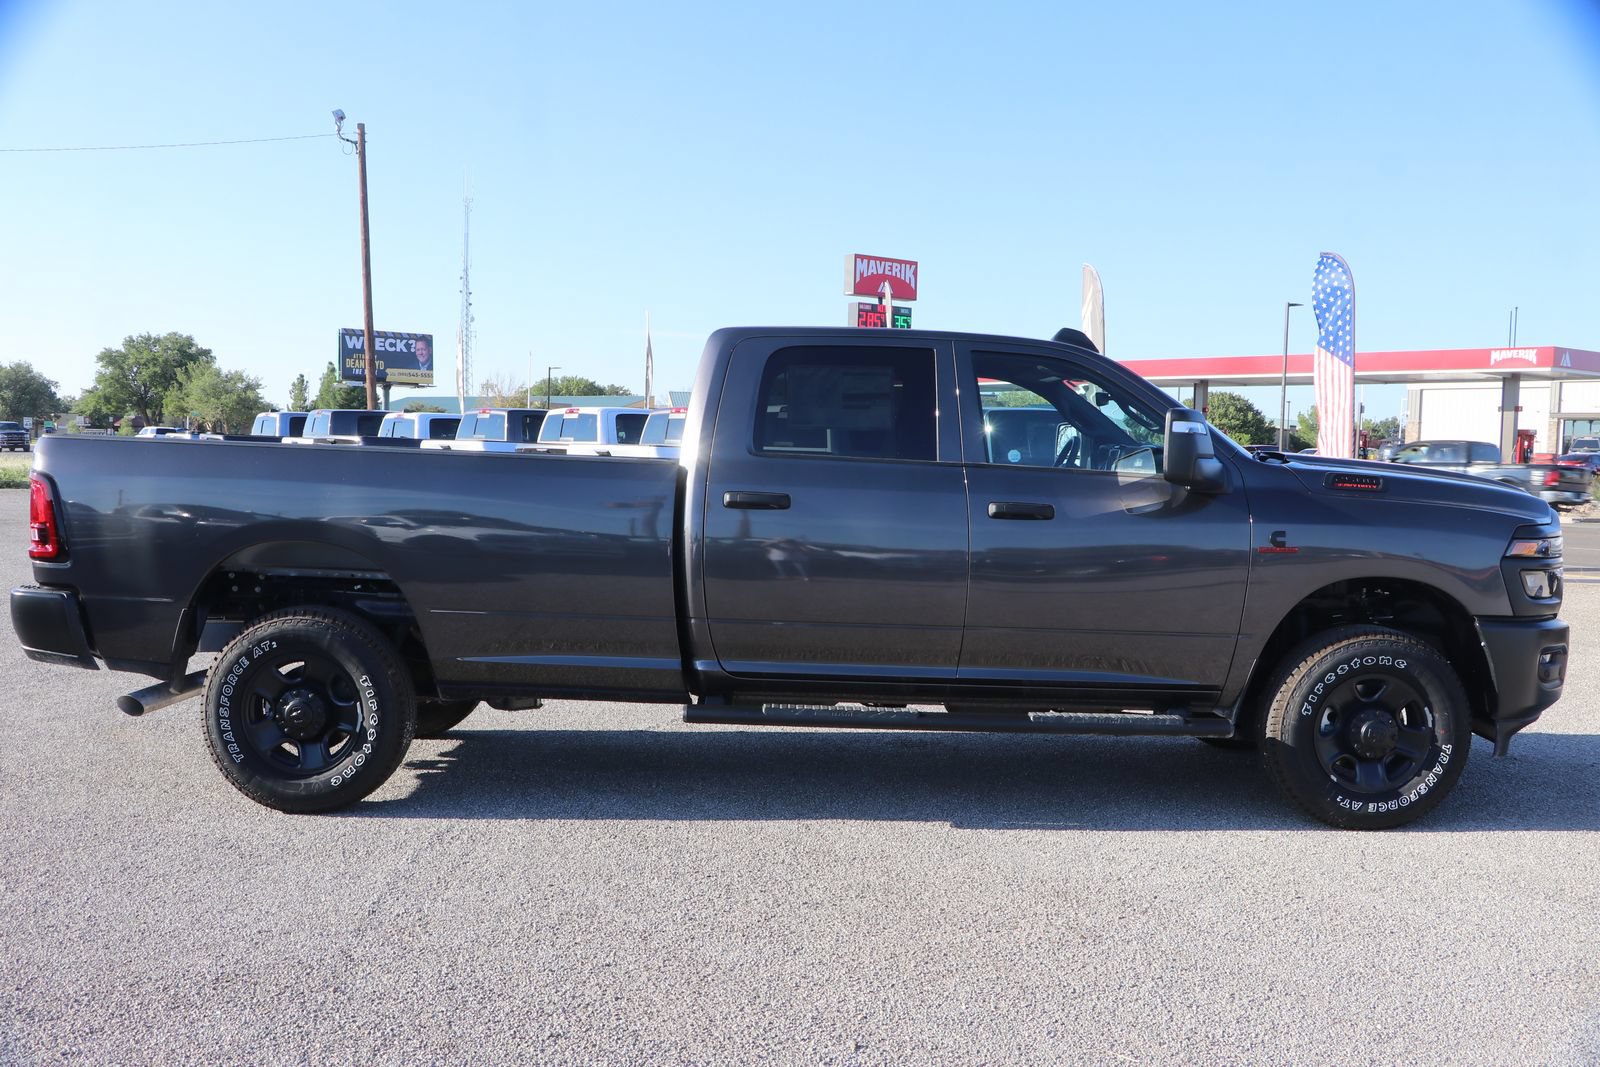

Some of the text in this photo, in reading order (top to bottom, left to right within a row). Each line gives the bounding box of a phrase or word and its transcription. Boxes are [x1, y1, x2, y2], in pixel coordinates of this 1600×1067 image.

[856, 258, 916, 290] MAVERIK
[344, 335, 416, 353] WECK?
[1490, 348, 1537, 366] MAVERIK
[346, 358, 365, 369] DEAN
[1301, 655, 1408, 716] Firestone
[219, 656, 250, 763] TRANSFORCE
[1368, 744, 1453, 813] TRANSFORCE
